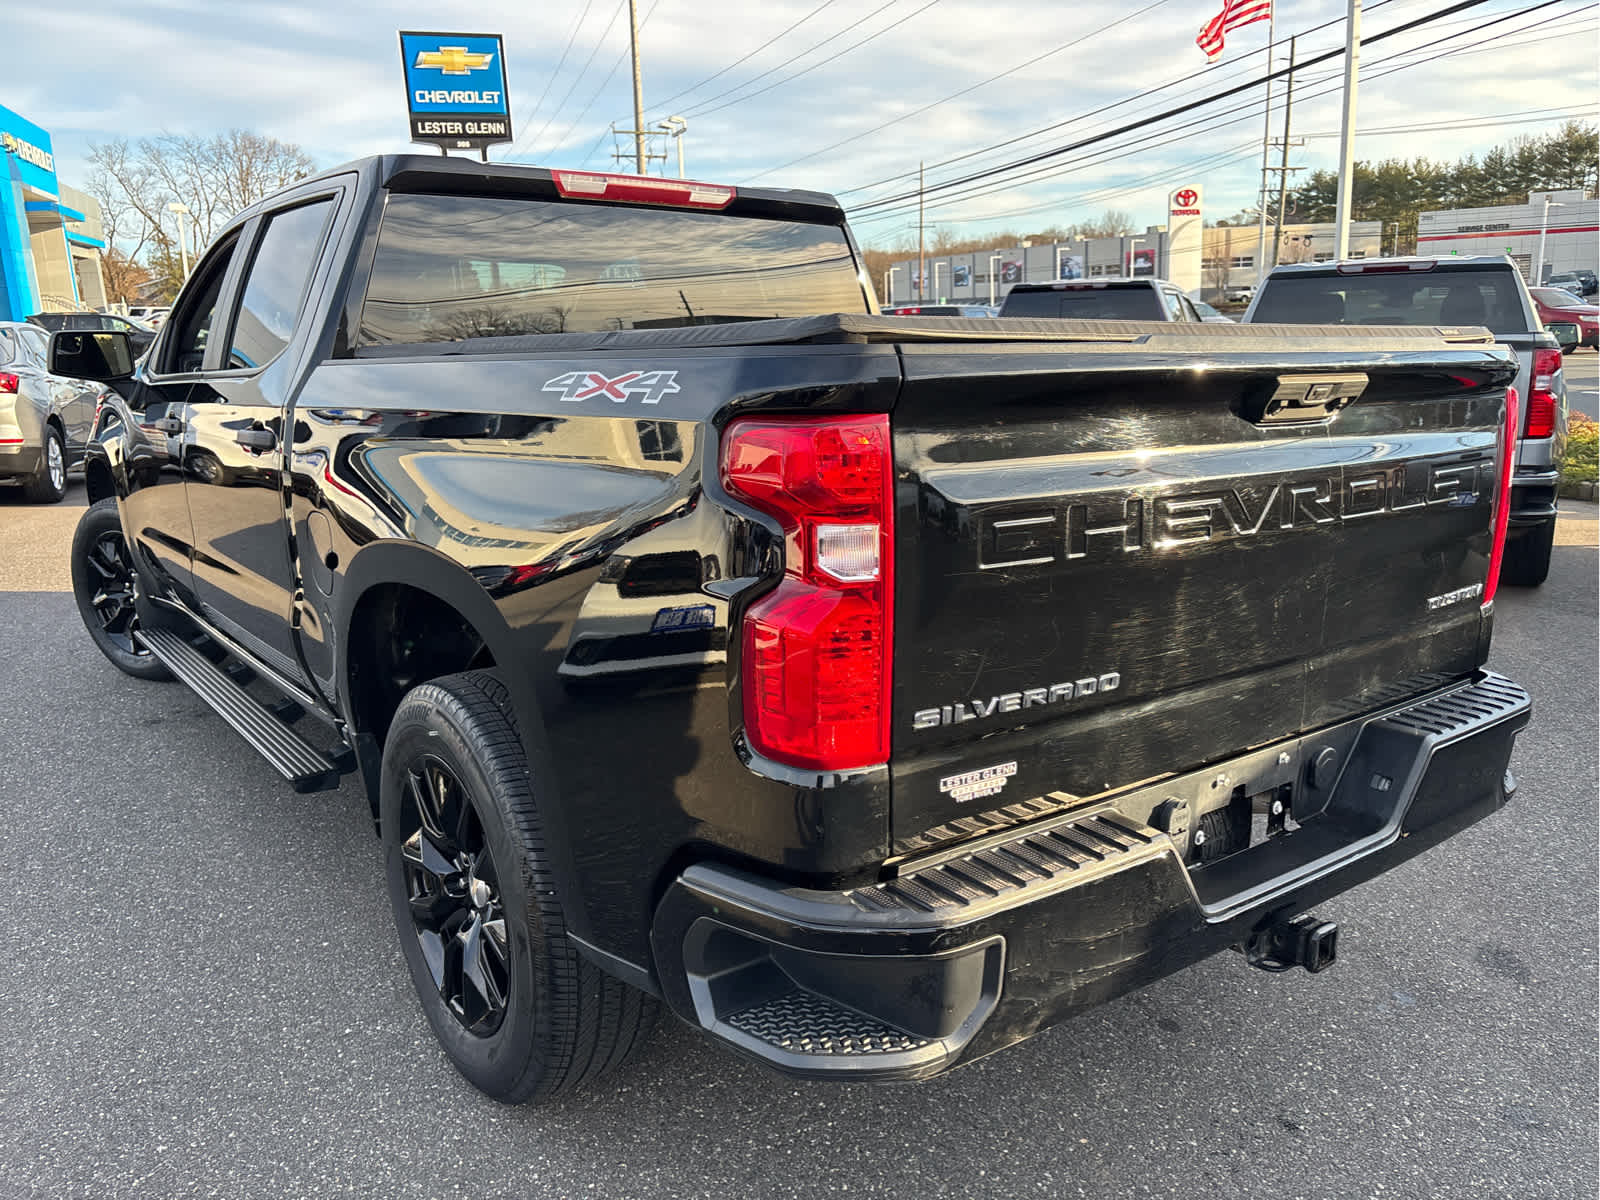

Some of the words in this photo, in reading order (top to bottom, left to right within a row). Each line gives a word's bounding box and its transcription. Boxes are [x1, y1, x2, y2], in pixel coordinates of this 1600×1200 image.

[415, 90, 500, 103] CHEVROLET
[417, 122, 462, 134] LESTER
[465, 123, 505, 134] GLENN
[976, 462, 1494, 570] CHEVROLET
[913, 672, 1121, 729] SILVERADO
[940, 773, 980, 790] LESTER
[983, 763, 1016, 778] GLENN
